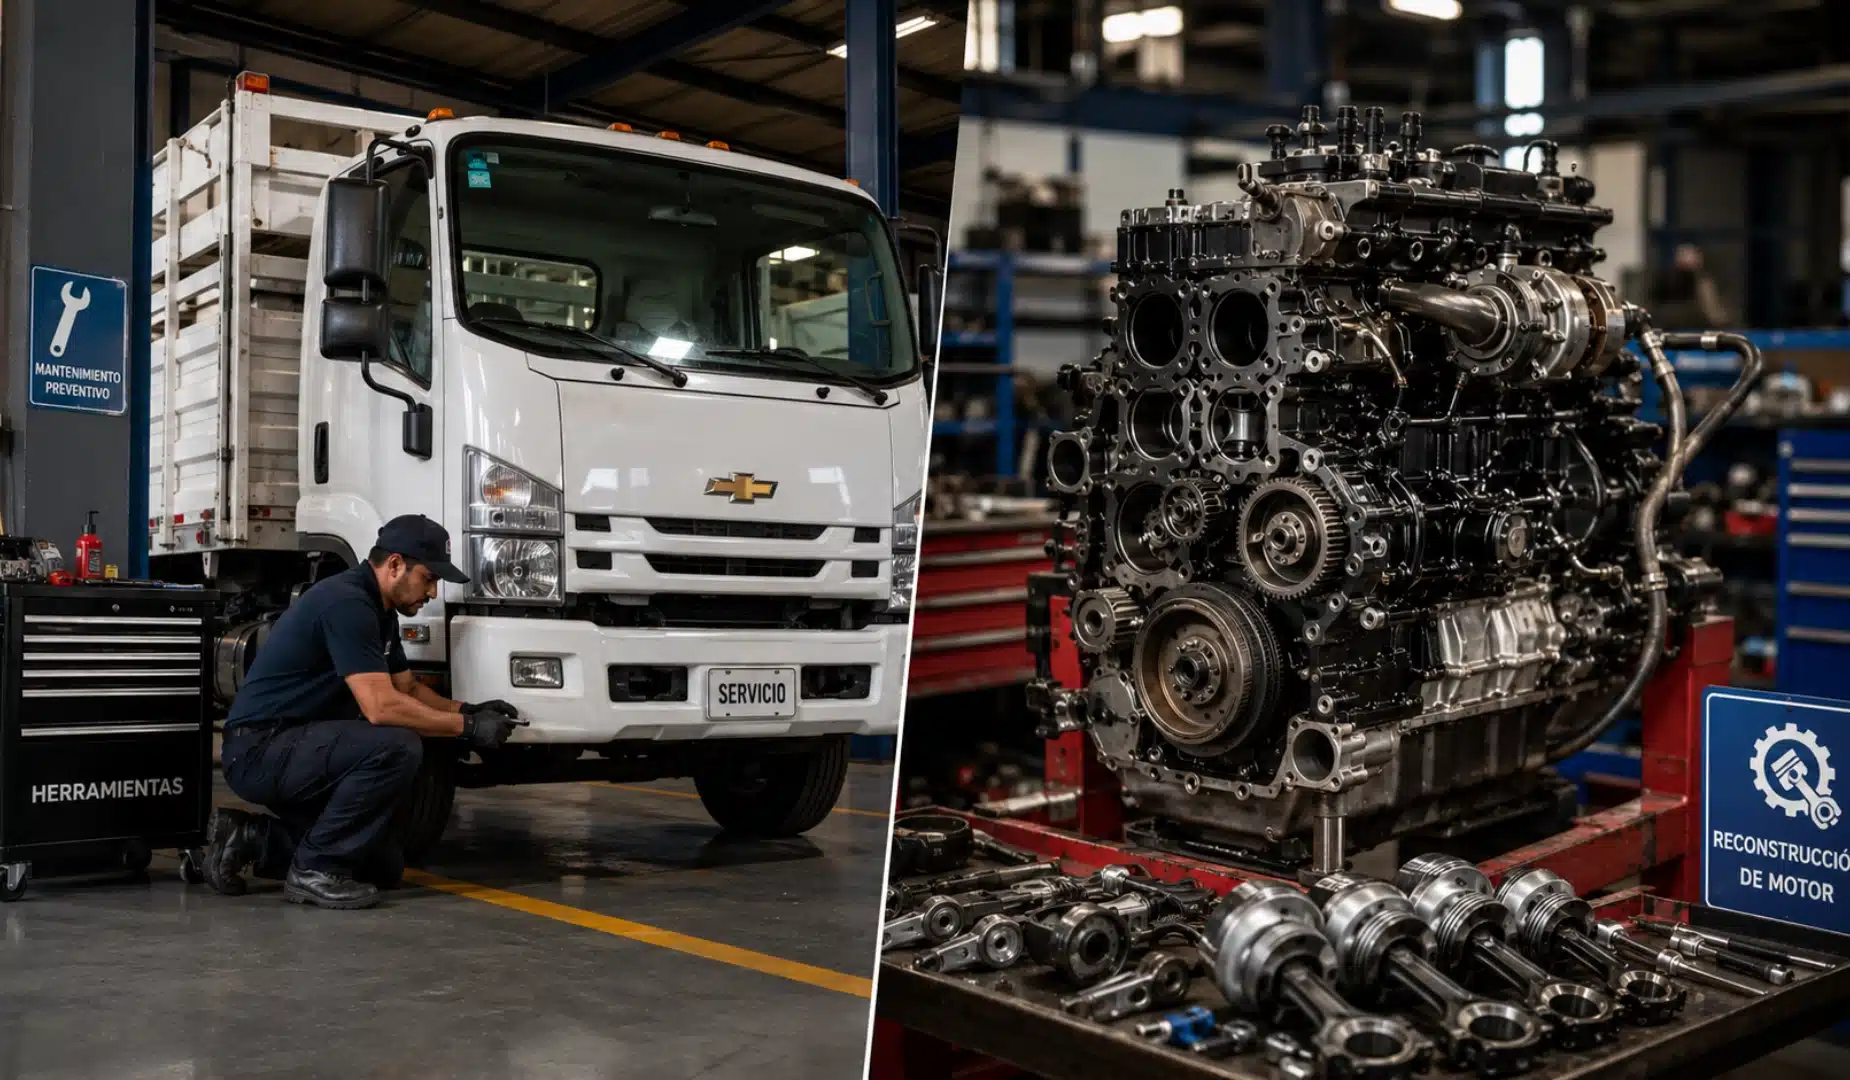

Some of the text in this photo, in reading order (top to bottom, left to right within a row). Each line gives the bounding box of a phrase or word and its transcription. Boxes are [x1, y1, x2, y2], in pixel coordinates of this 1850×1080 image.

[35, 362, 121, 384] MANTENIMIENTO
[45, 381, 110, 400] PREVENTIVO
[718, 683, 786, 704] SERVICIO
[32, 777, 184, 803] HERRAMIENTAS
[1713, 830, 1850, 872] RECONSTRUCCIÓ
[1740, 867, 1834, 903] DE MOTOR
